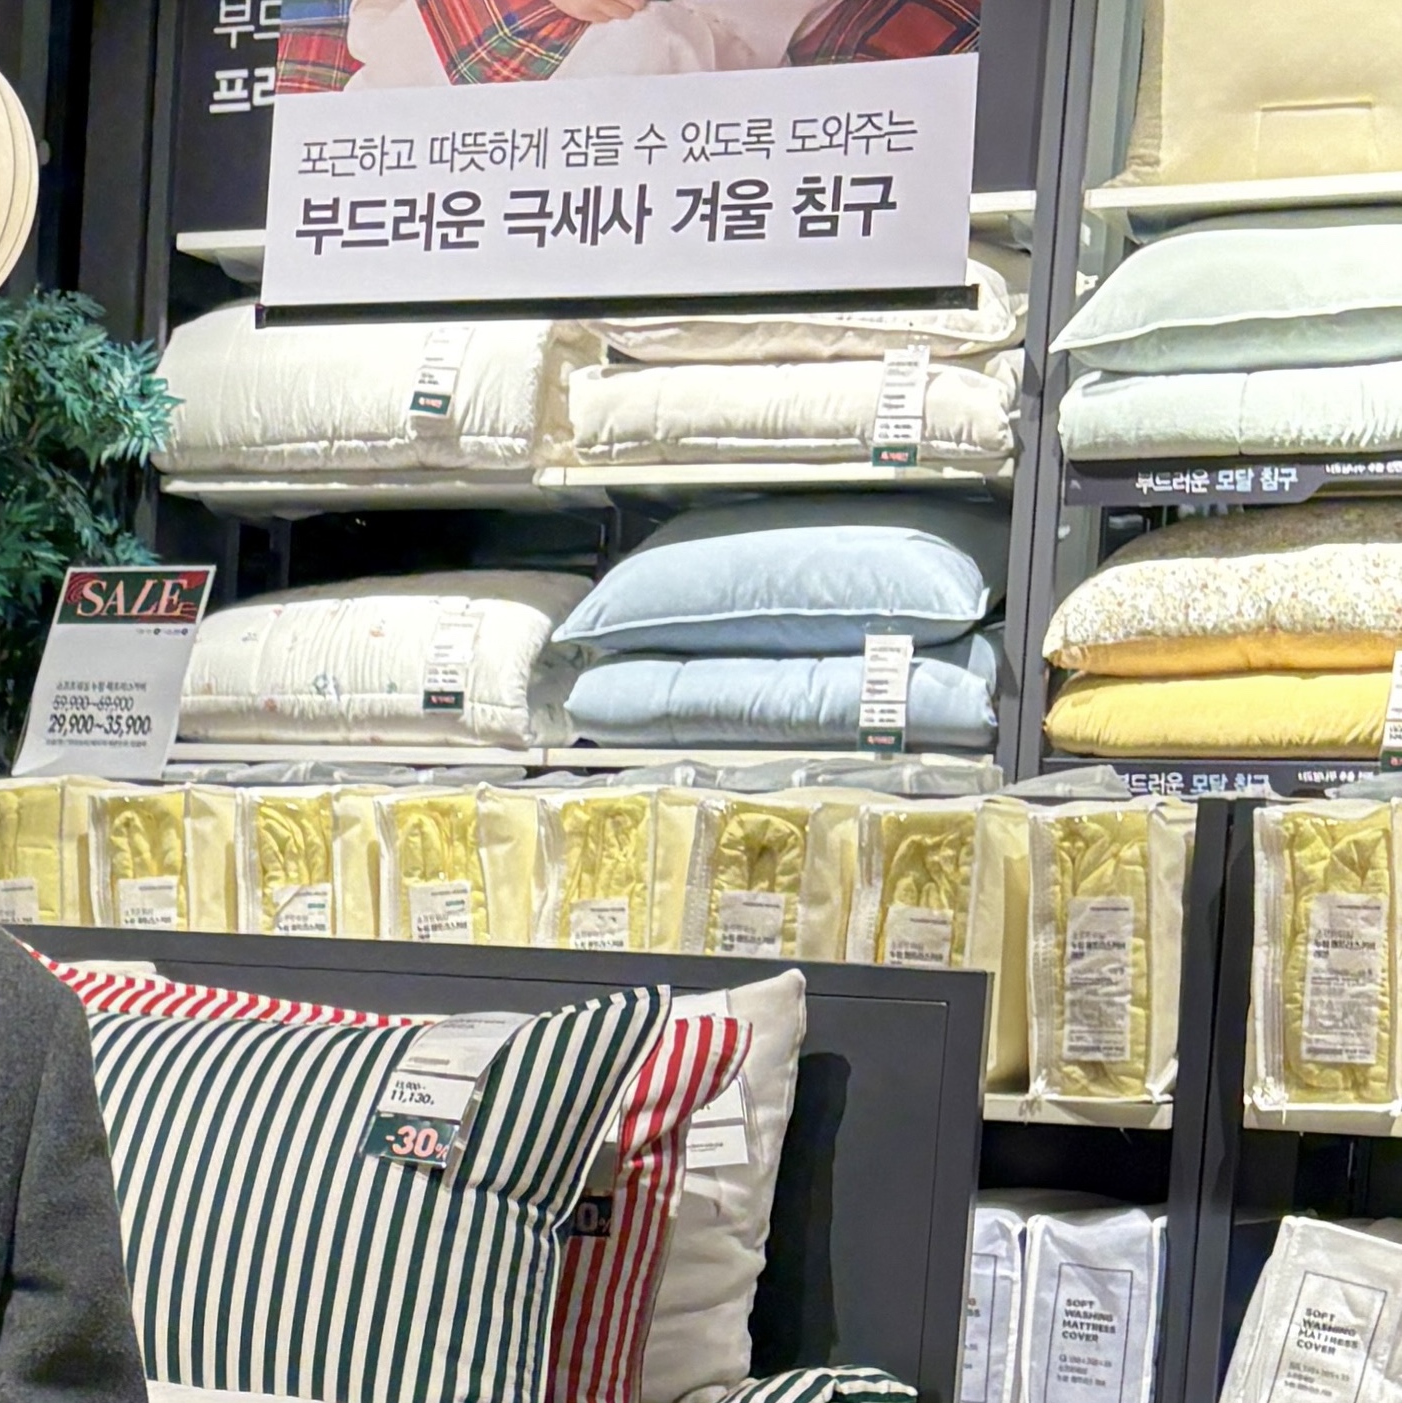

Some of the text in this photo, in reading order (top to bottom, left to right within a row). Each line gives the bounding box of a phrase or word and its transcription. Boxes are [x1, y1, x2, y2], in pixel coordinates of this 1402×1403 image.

[298, 110, 918, 177] 포근하고 따뜻하게 잠들 수 있도록 도와주는
[295, 175, 897, 256] 부드러운 극세사 겨울 침구
[1215, 467, 1255, 492] 모달
[1259, 466, 1298, 491] 침구
[75, 578, 189, 617] SALE
[385, 1124, 449, 1160] -30%
[1066, 1298, 1094, 1309] SOFT
[1305, 1307, 1337, 1323] SOFT
[1061, 1330, 1099, 1343] COVER
[1062, 1320, 1116, 1334] MATTRESS
[1296, 1339, 1337, 1356] COVER
[1298, 1328, 1360, 1350] MATTRESS
